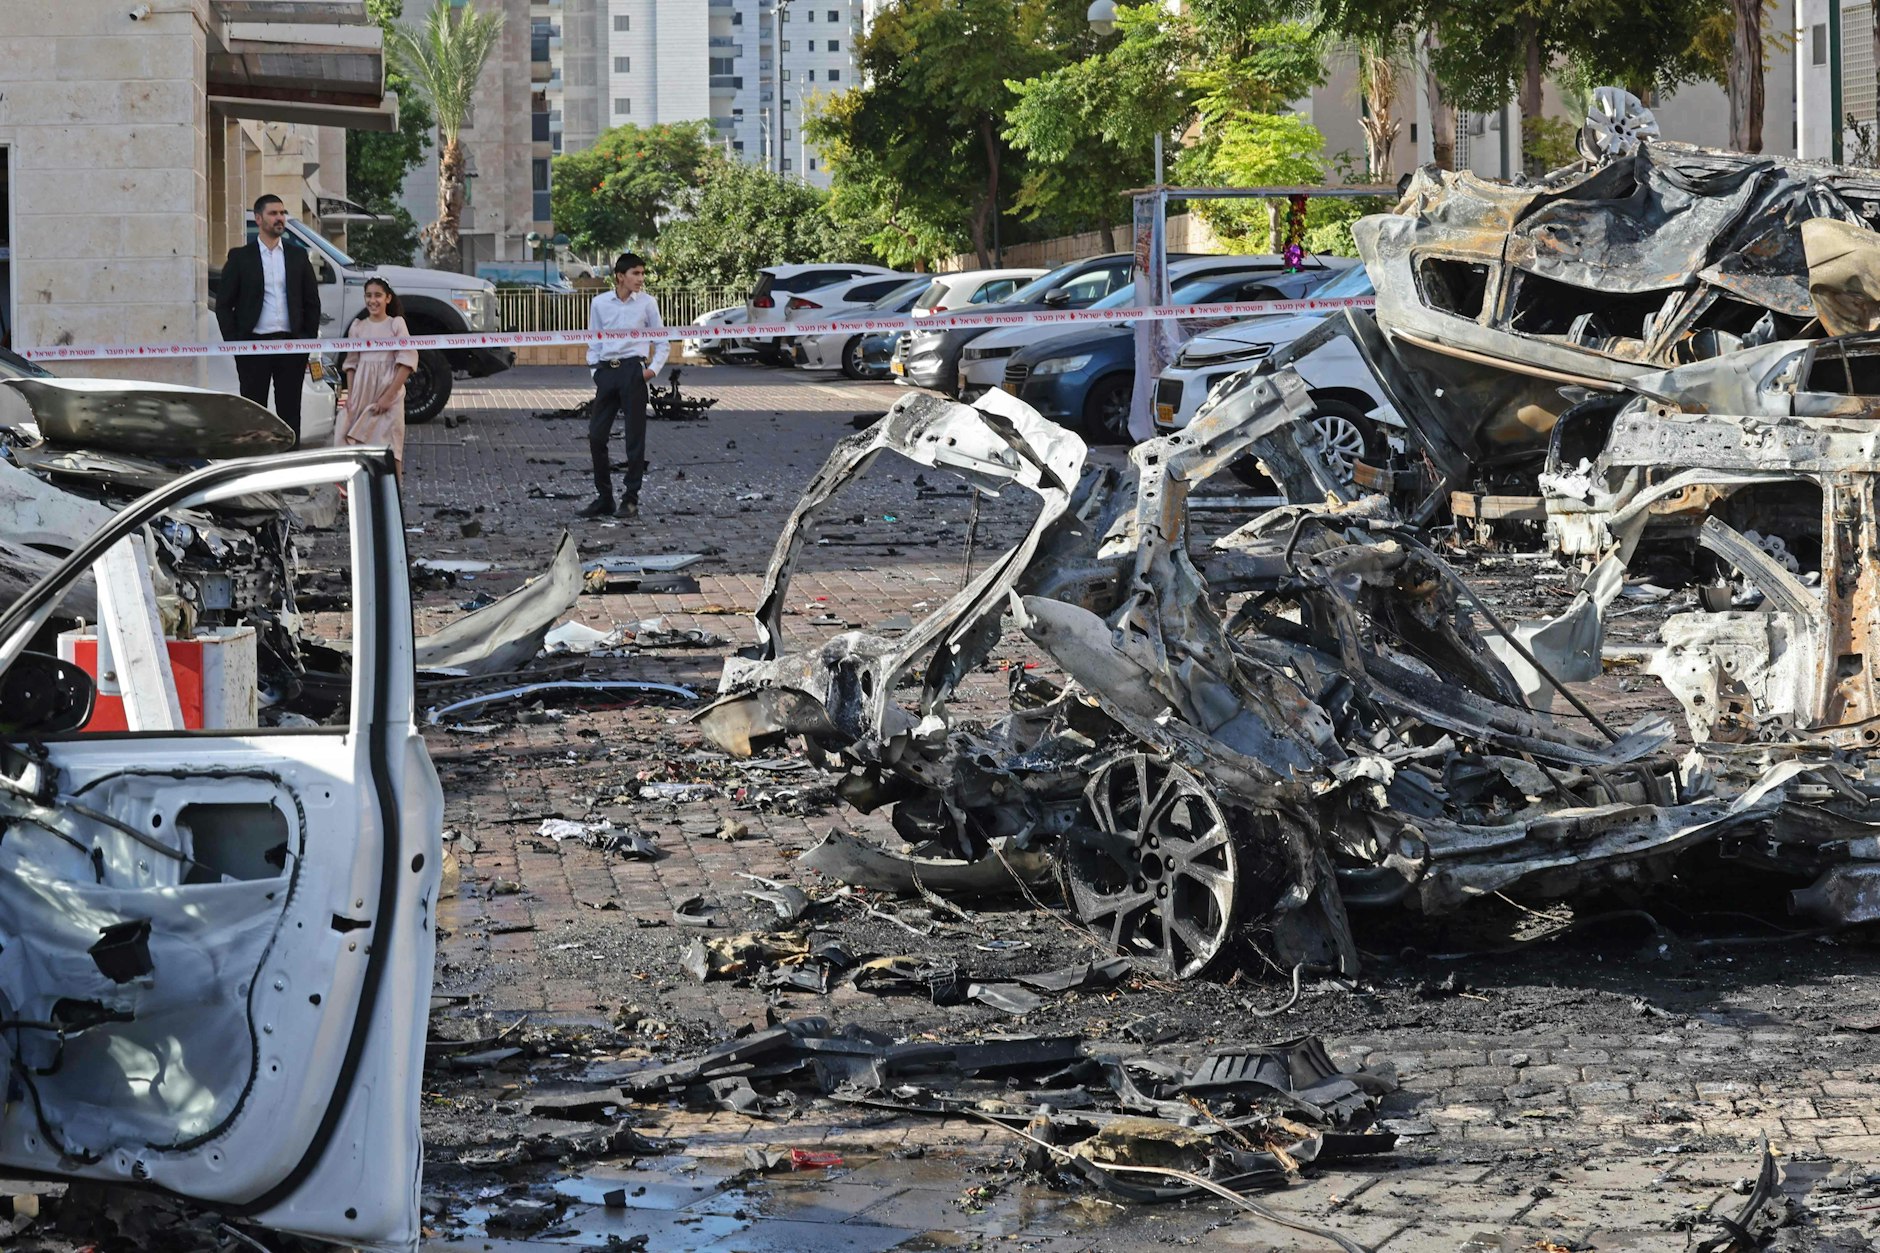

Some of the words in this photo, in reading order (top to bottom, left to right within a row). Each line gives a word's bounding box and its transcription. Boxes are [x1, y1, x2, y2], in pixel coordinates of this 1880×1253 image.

[1319, 300, 1342, 308] ישראל
[1356, 298, 1376, 306] שטרת
[1199, 306, 1222, 314] ישראל
[1235, 305, 1264, 313] משטרת
[1274, 303, 1294, 311] מעבר
[1079, 312, 1102, 320] ישראל
[1116, 310, 1143, 318] משטרת
[1154, 308, 1174, 316] מעבר
[959, 317, 982, 325] ישראל
[996, 316, 1024, 324] משטרת
[1034, 314, 1055, 322] מעבר
[841, 322, 864, 330] ישראל
[877, 321, 905, 329] משטרת
[914, 319, 935, 327] מעבר
[723, 327, 745, 335] ישראל
[759, 326, 786, 334] משטרת
[796, 324, 817, 332] מעבר
[606, 332, 628, 340] ישראל
[642, 331, 669, 339] משטרת
[679, 329, 699, 337] מעבר
[447, 338, 466, 346] מעבר
[490, 337, 512, 345] ישראל
[525, 335, 553, 343] משטרת
[562, 334, 582, 342] מעבר
